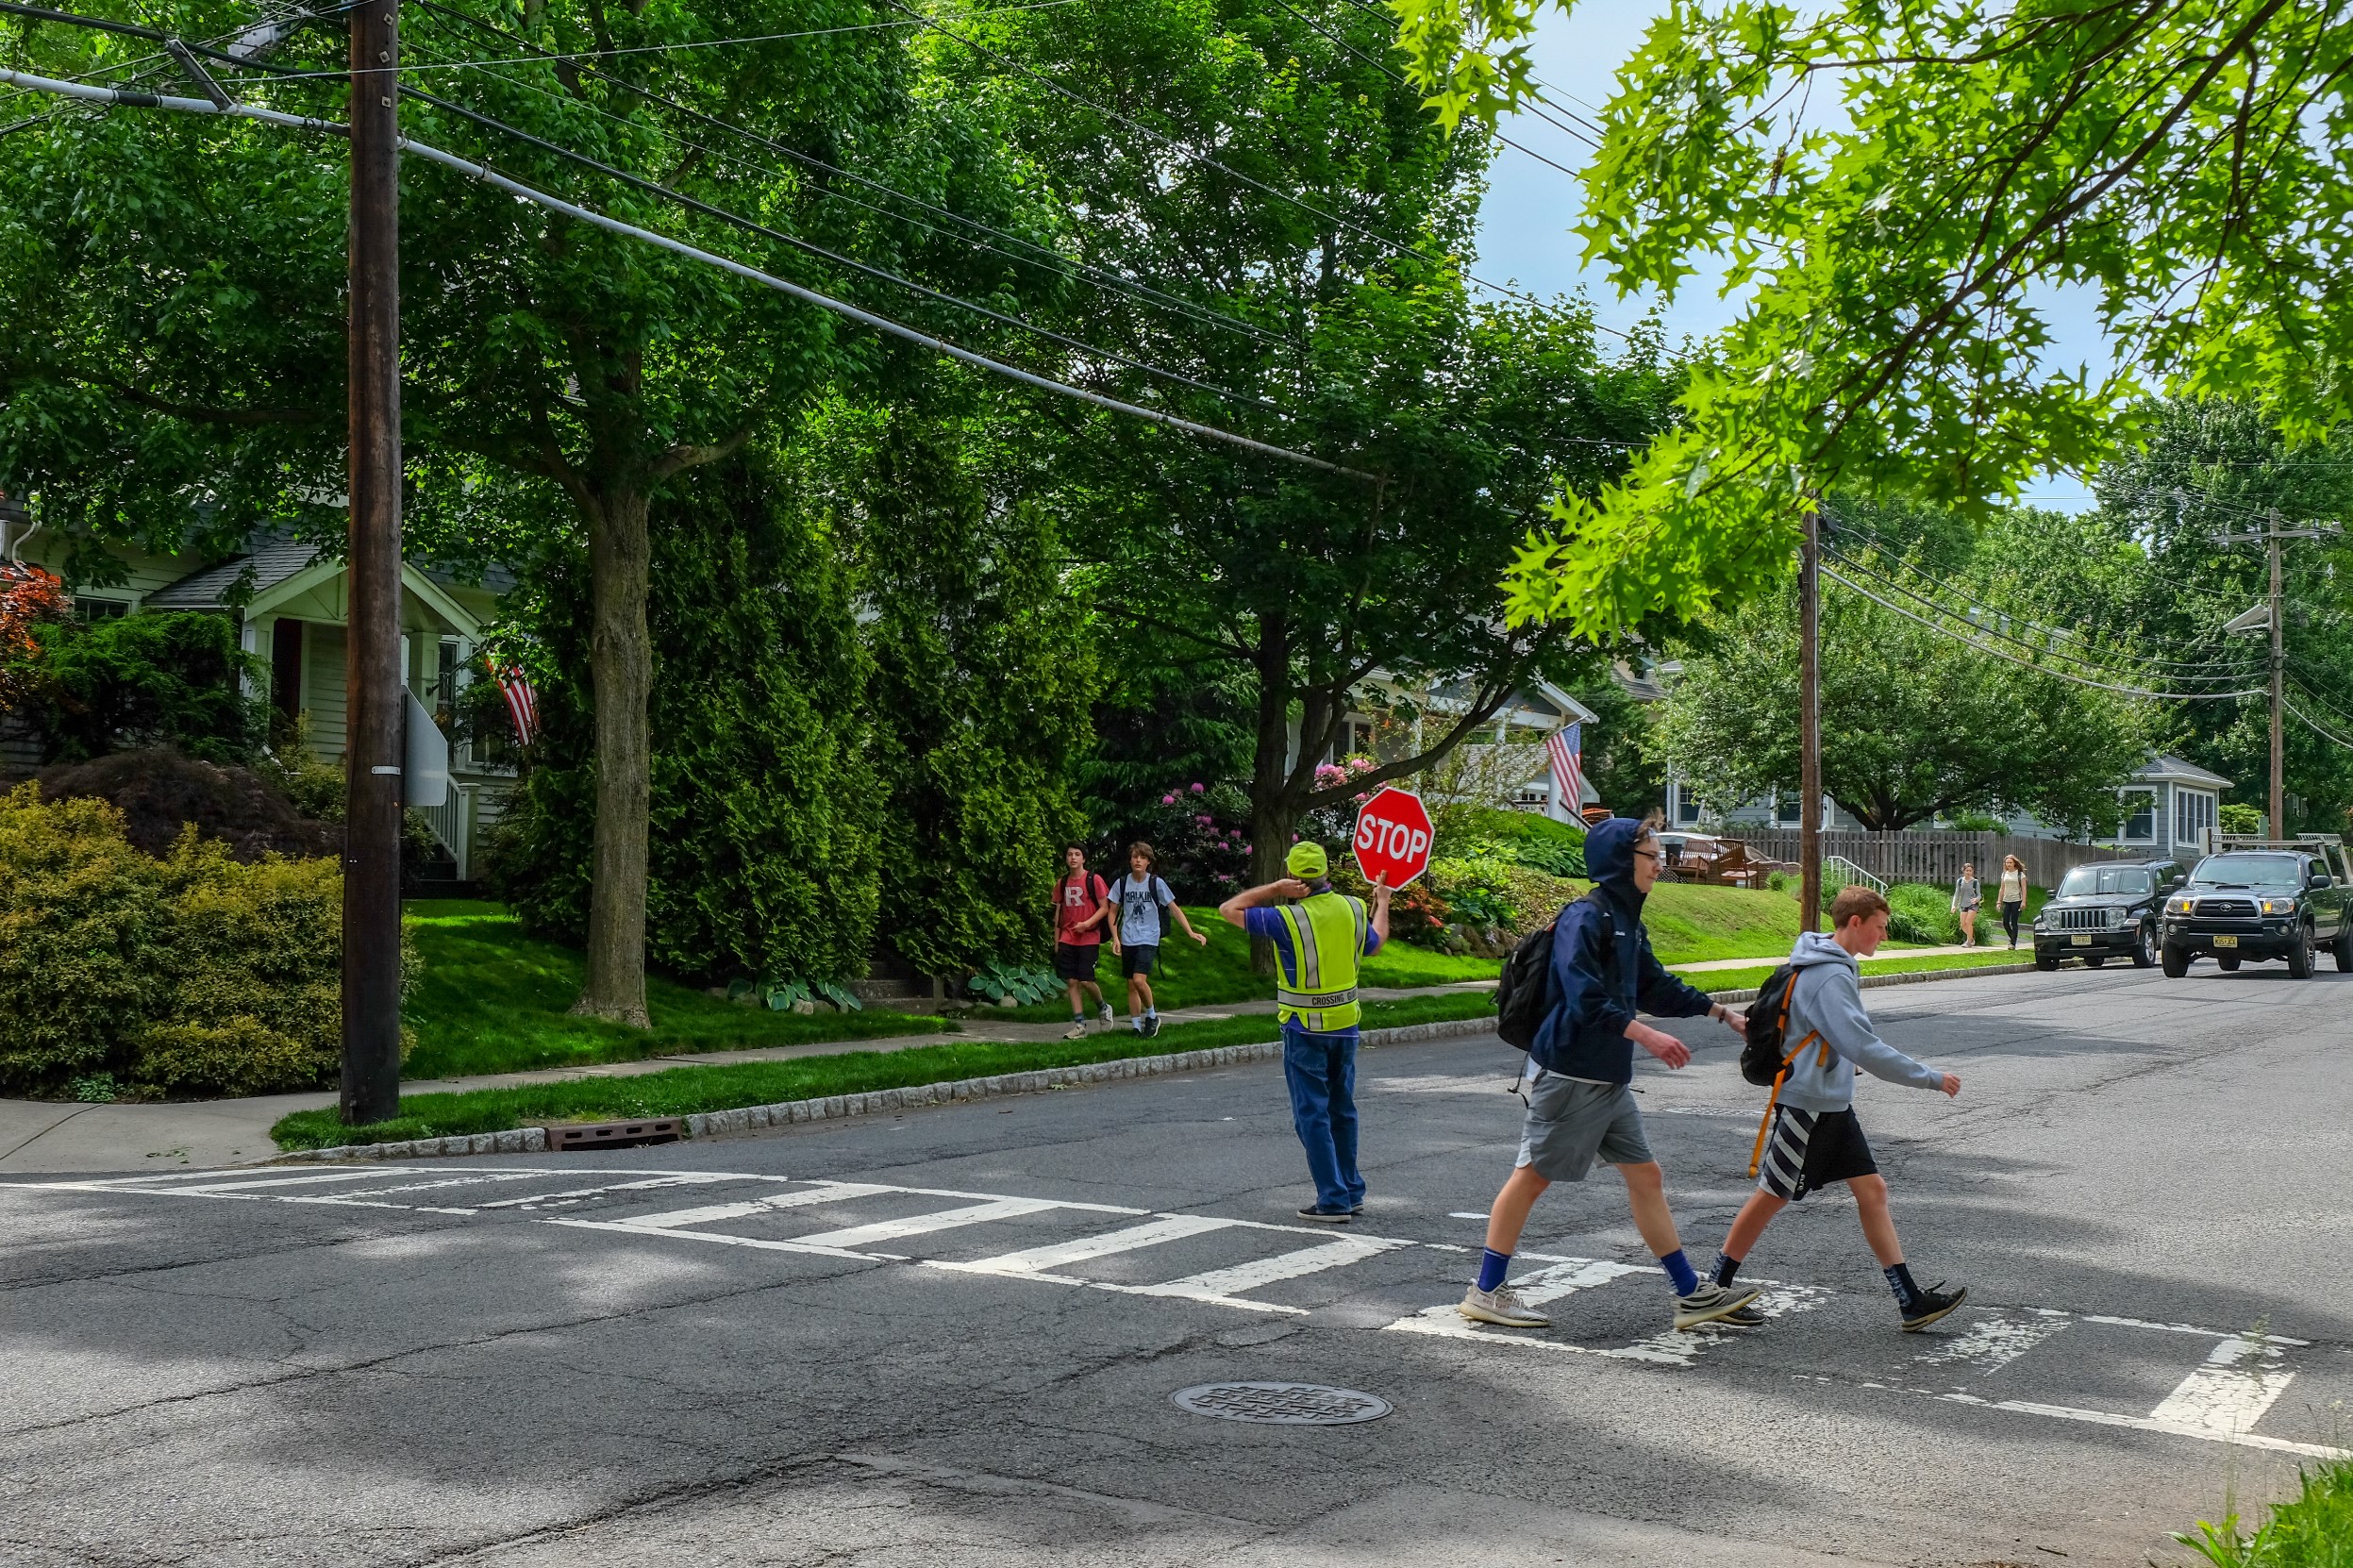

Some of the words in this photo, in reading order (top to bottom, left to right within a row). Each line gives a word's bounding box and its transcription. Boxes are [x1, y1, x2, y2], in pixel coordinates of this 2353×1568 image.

[1358, 814, 1427, 863] STOP
[1065, 887, 1085, 907] R
[1312, 993, 1343, 1006] CROSSING
